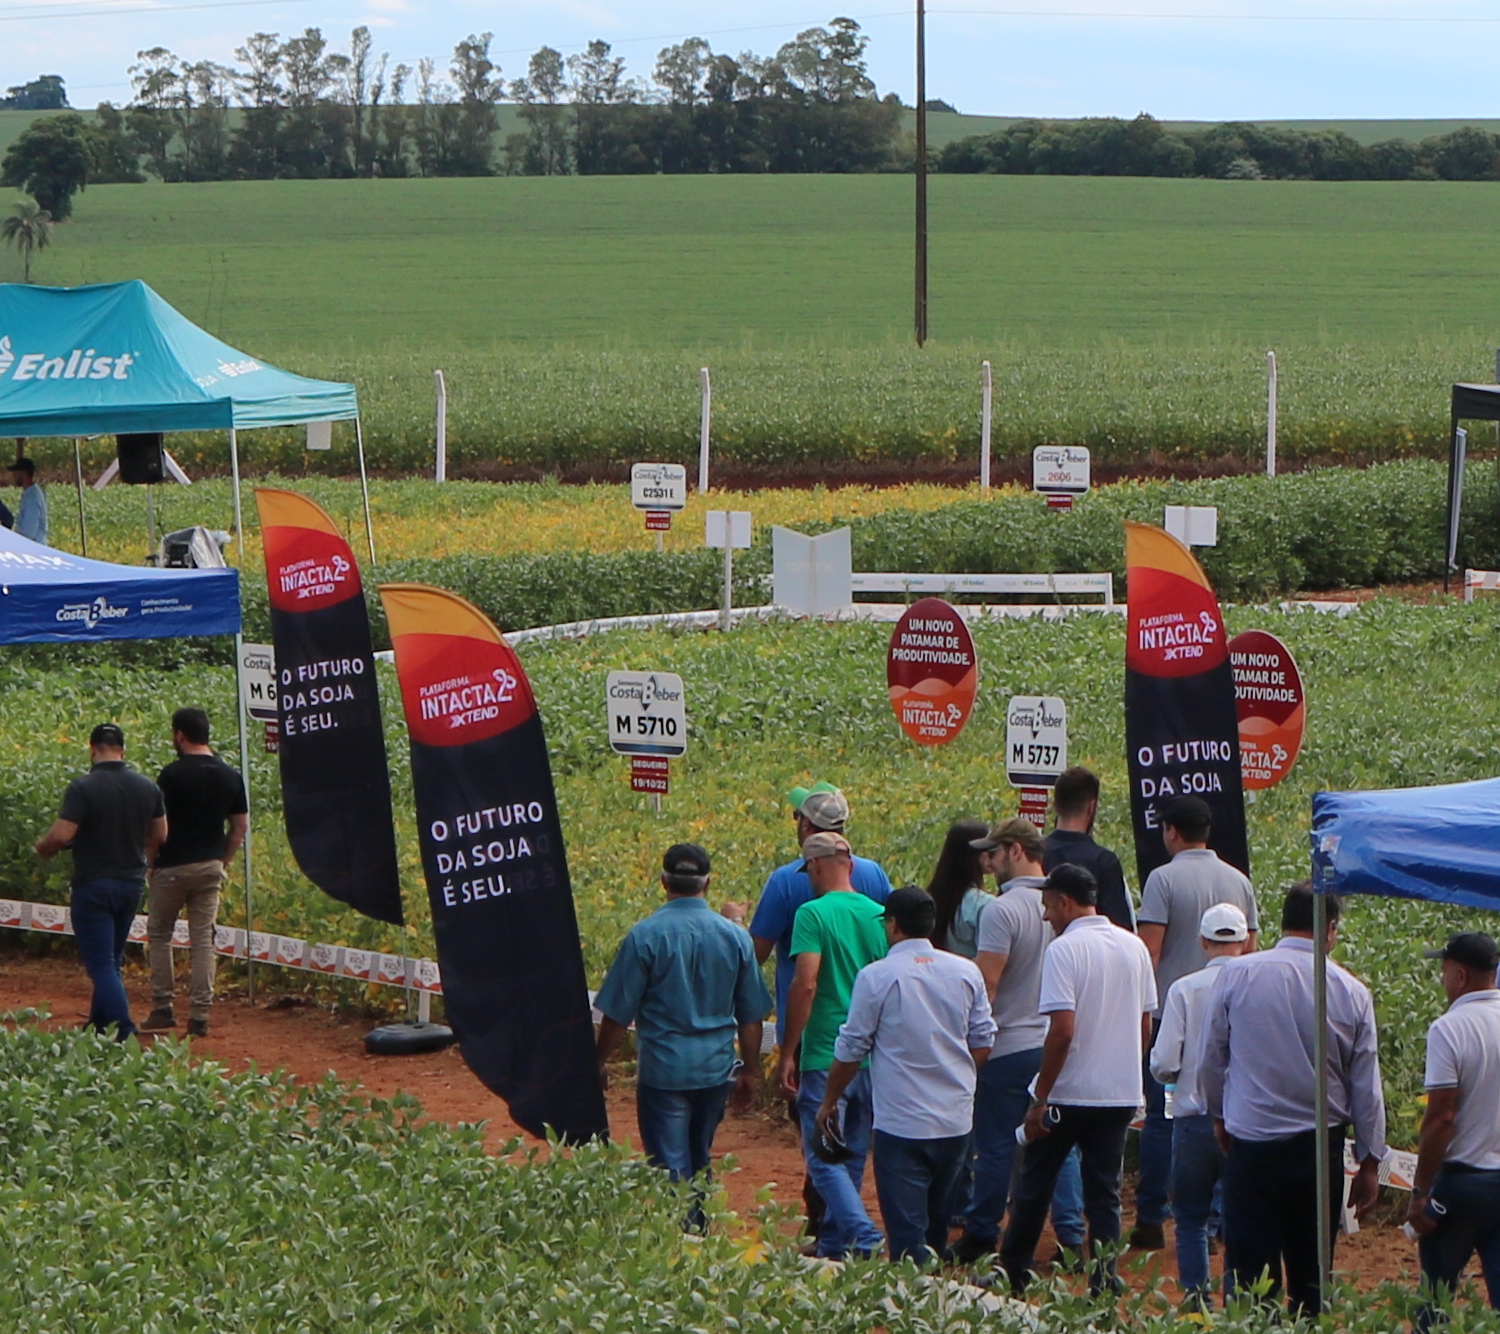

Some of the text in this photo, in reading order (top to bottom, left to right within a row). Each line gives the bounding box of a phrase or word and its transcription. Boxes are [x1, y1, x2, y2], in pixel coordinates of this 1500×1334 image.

[11, 348, 134, 381] Enlist
[909, 619, 954, 633] UM NOVO
[1139, 613, 1184, 627] PLATAFORMA
[900, 634, 959, 649] PATAMAR DE
[892, 648, 970, 666] PRODUTIVIDADE.
[1231, 653, 1279, 667] UM NOVO
[281, 657, 365, 686] O FUTURO
[1271, 671, 1285, 685] DE
[250, 682, 263, 700] M
[283, 684, 355, 711] DA SOJA
[420, 675, 470, 697] PLATAFORMA
[610, 679, 680, 704] CostaBeber
[285, 712, 339, 736] É SEU.
[616, 715, 677, 736] M 5710
[633, 760, 667, 769] SEQUEIRO
[1013, 743, 1060, 766] M 5737
[1138, 740, 1231, 767] O FUTURO
[1141, 772, 1222, 798] DA SOJA
[431, 801, 544, 842] O FUTURO
[1144, 803, 1159, 829] É
[436, 836, 532, 875] DA SOJA
[442, 875, 512, 907] É SEU.
